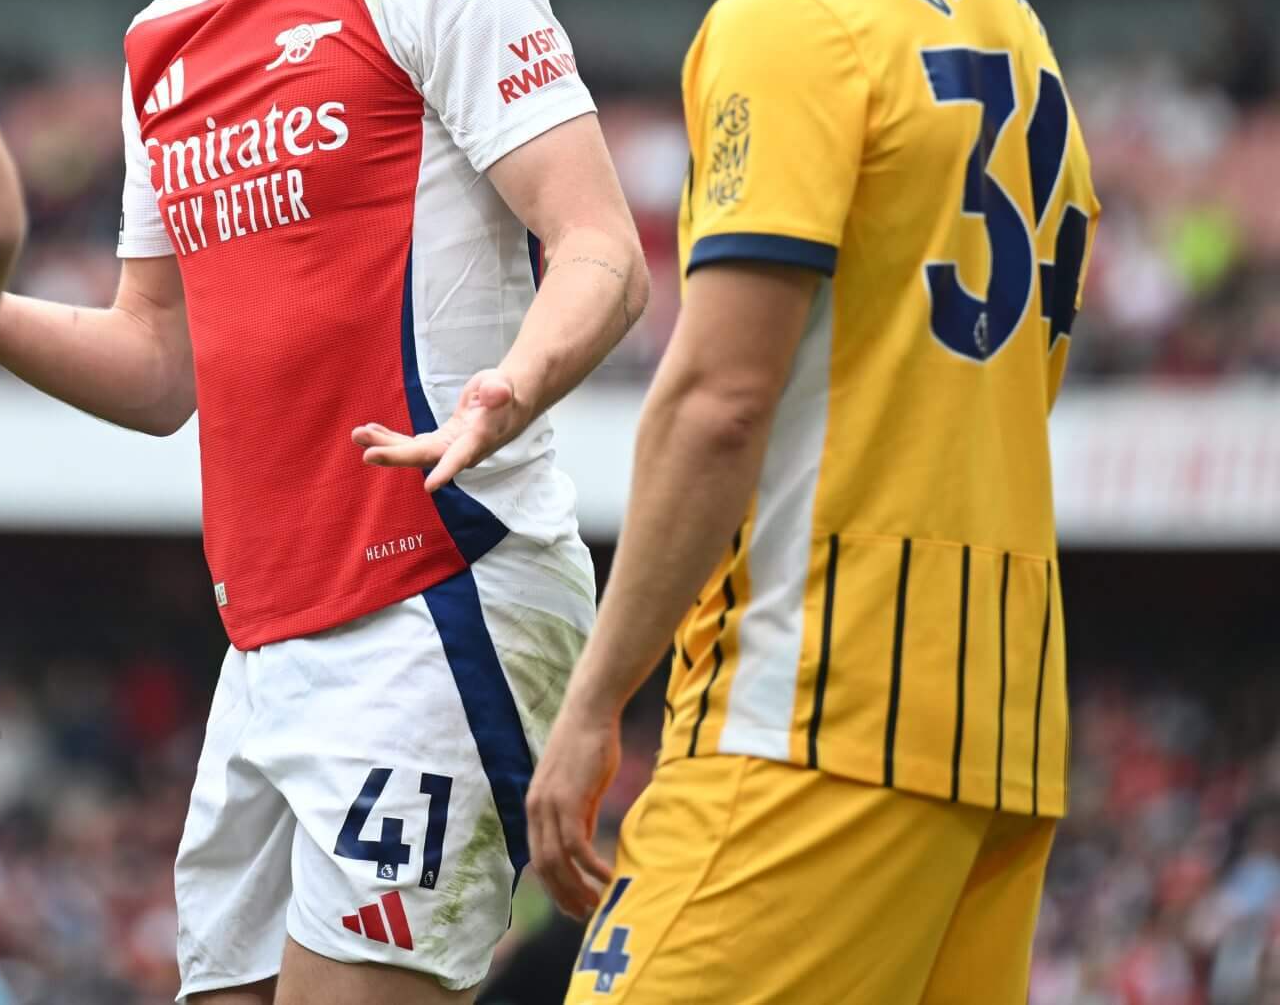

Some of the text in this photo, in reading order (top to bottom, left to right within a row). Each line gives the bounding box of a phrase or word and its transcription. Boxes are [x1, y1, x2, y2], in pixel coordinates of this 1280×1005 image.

[507, 27, 560, 63] VISIT
[144, 101, 349, 196] Emirates
[167, 194, 208, 256] FLY
[213, 168, 311, 242] BETTER
[918, 47, 1091, 364] 34
[365, 533, 423, 562] HEAT.RDY
[333, 767, 454, 890] 41
